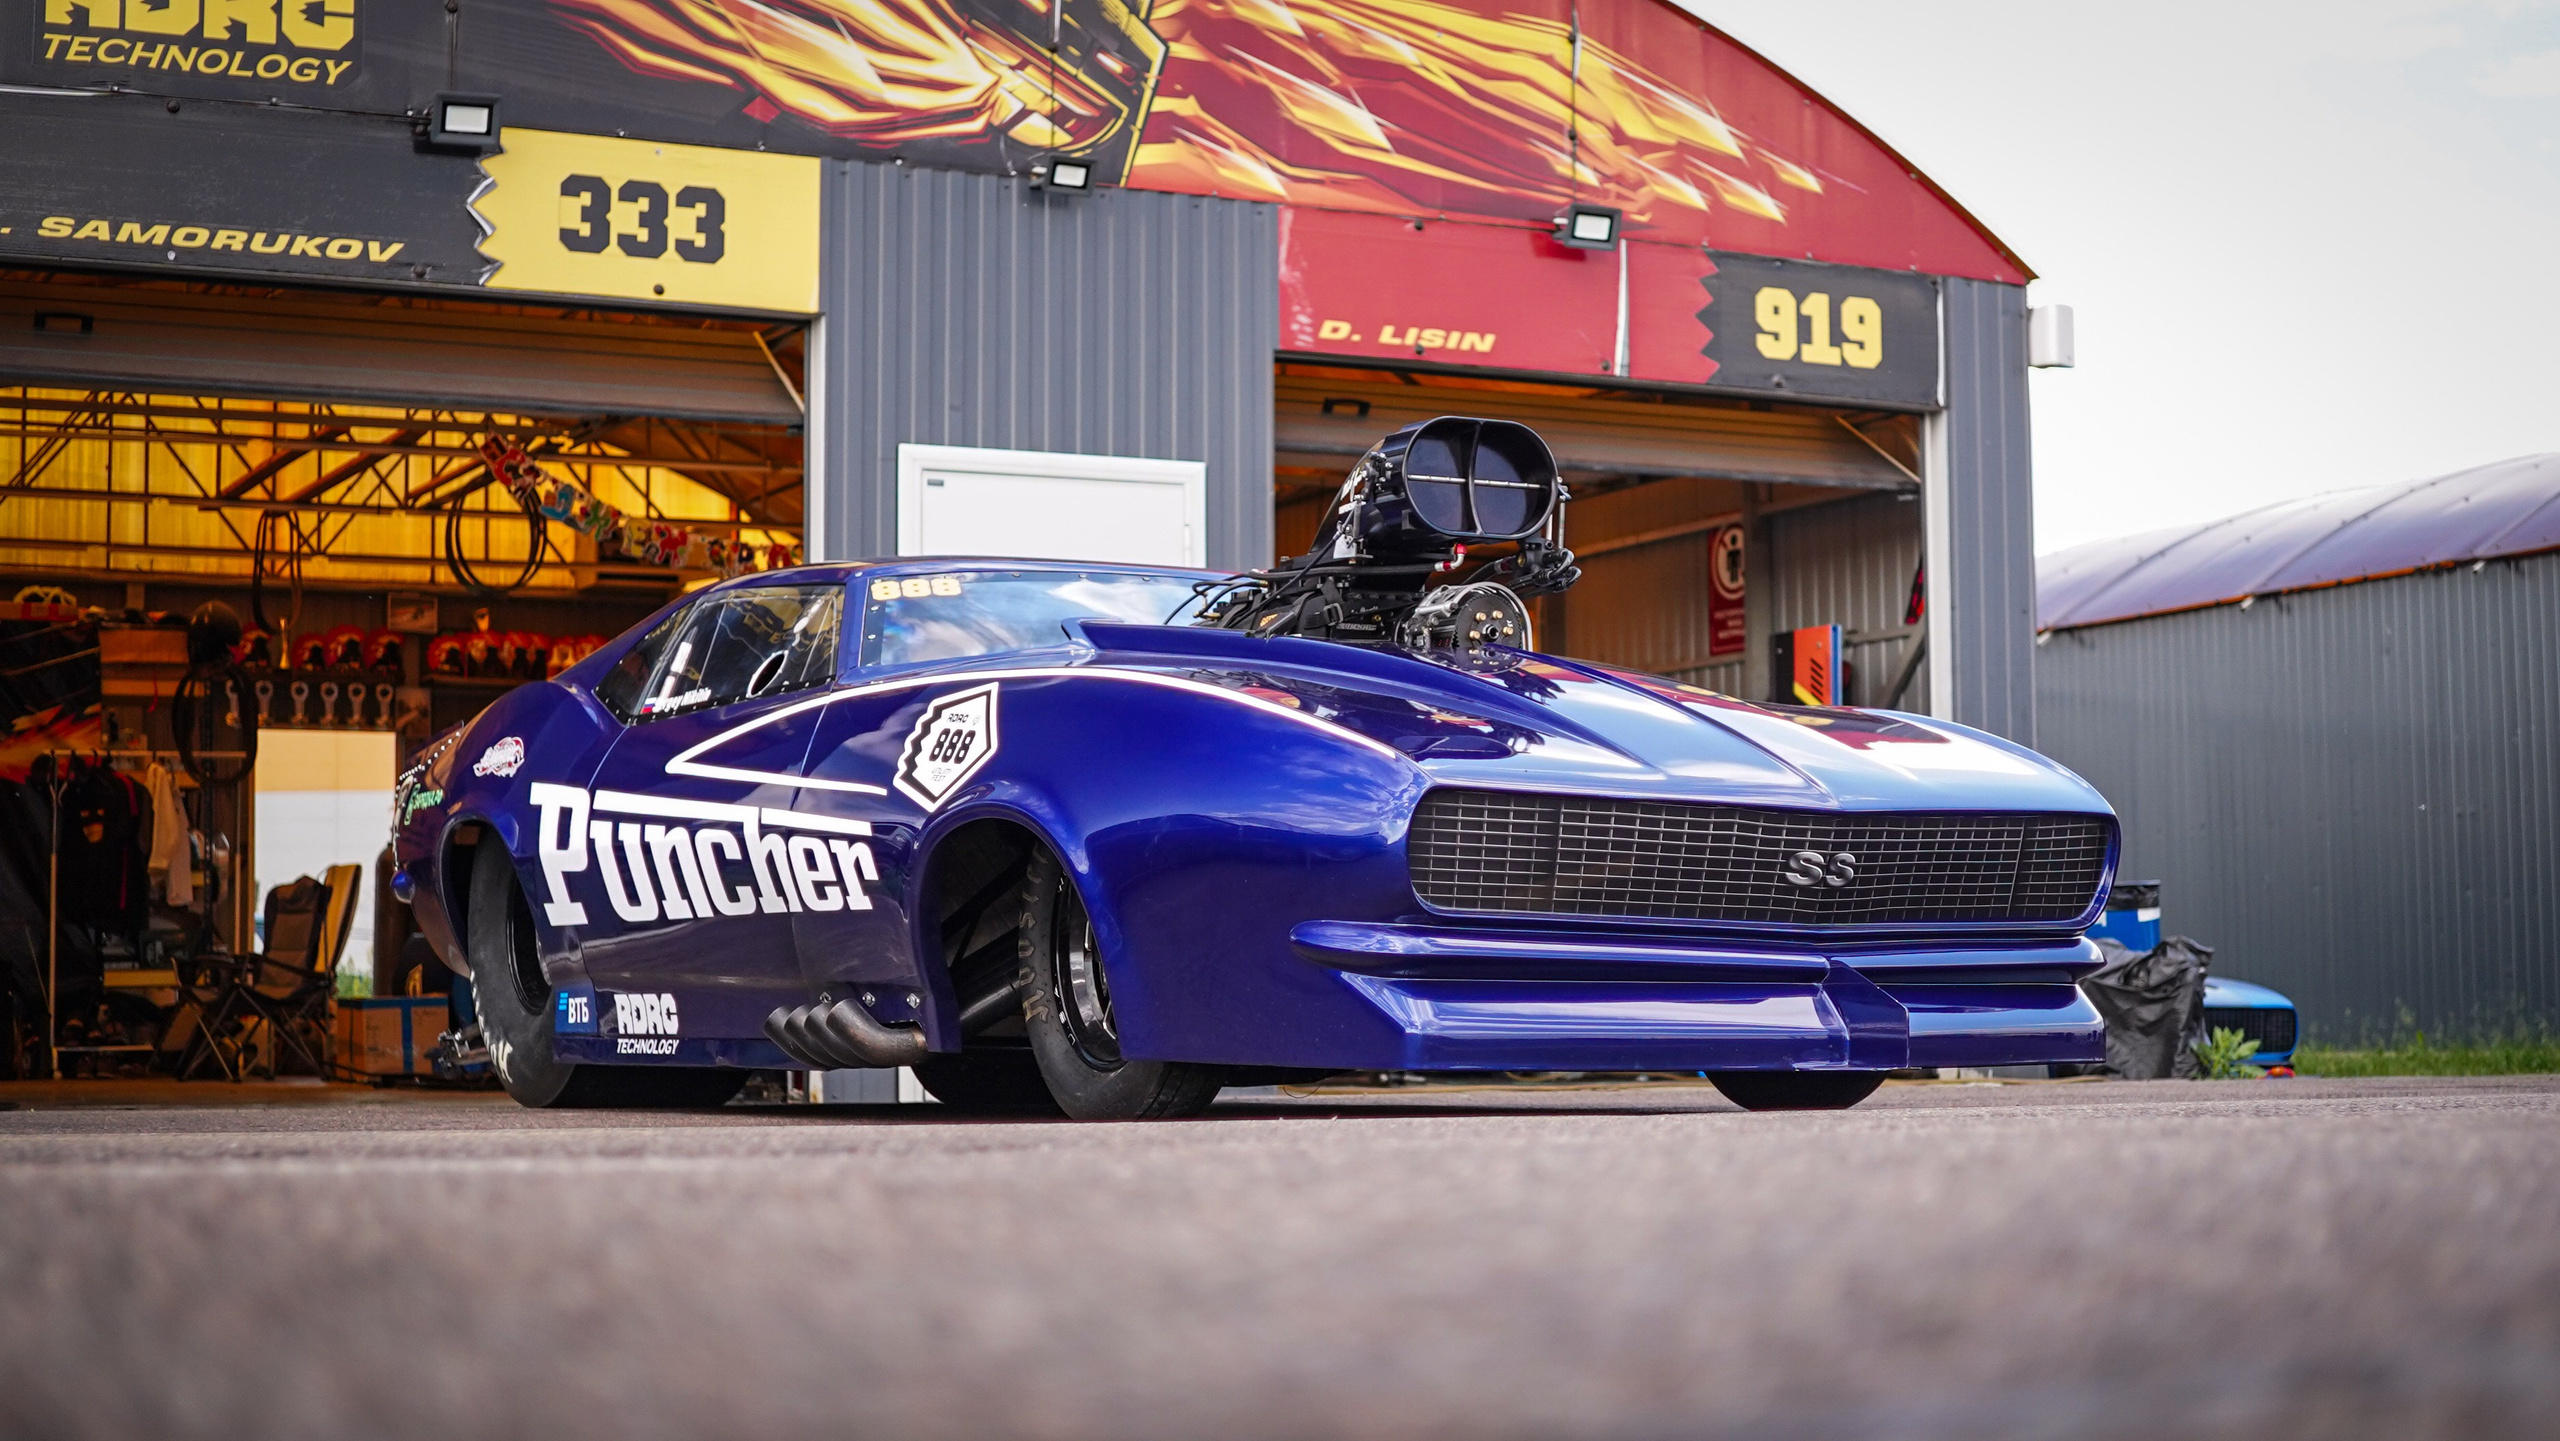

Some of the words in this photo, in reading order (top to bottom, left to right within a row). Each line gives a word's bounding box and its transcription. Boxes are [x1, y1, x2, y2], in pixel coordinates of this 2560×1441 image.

[43, 33, 353, 86] TECHNOLOGY
[559, 173, 726, 264] 333
[37, 216, 404, 263] SAMORUKOV
[1318, 319, 1362, 342] D.
[1378, 325, 1496, 353] LISIN
[1755, 286, 1883, 369] 919
[871, 579, 962, 601] 888
[929, 728, 976, 764] 888
[530, 782, 879, 926] Puncher
[1786, 851, 1856, 887] SS
[568, 997, 589, 1024] ВТБ
[613, 993, 679, 1035] RDRC
[616, 1038, 680, 1055] TECHNOLOGY
